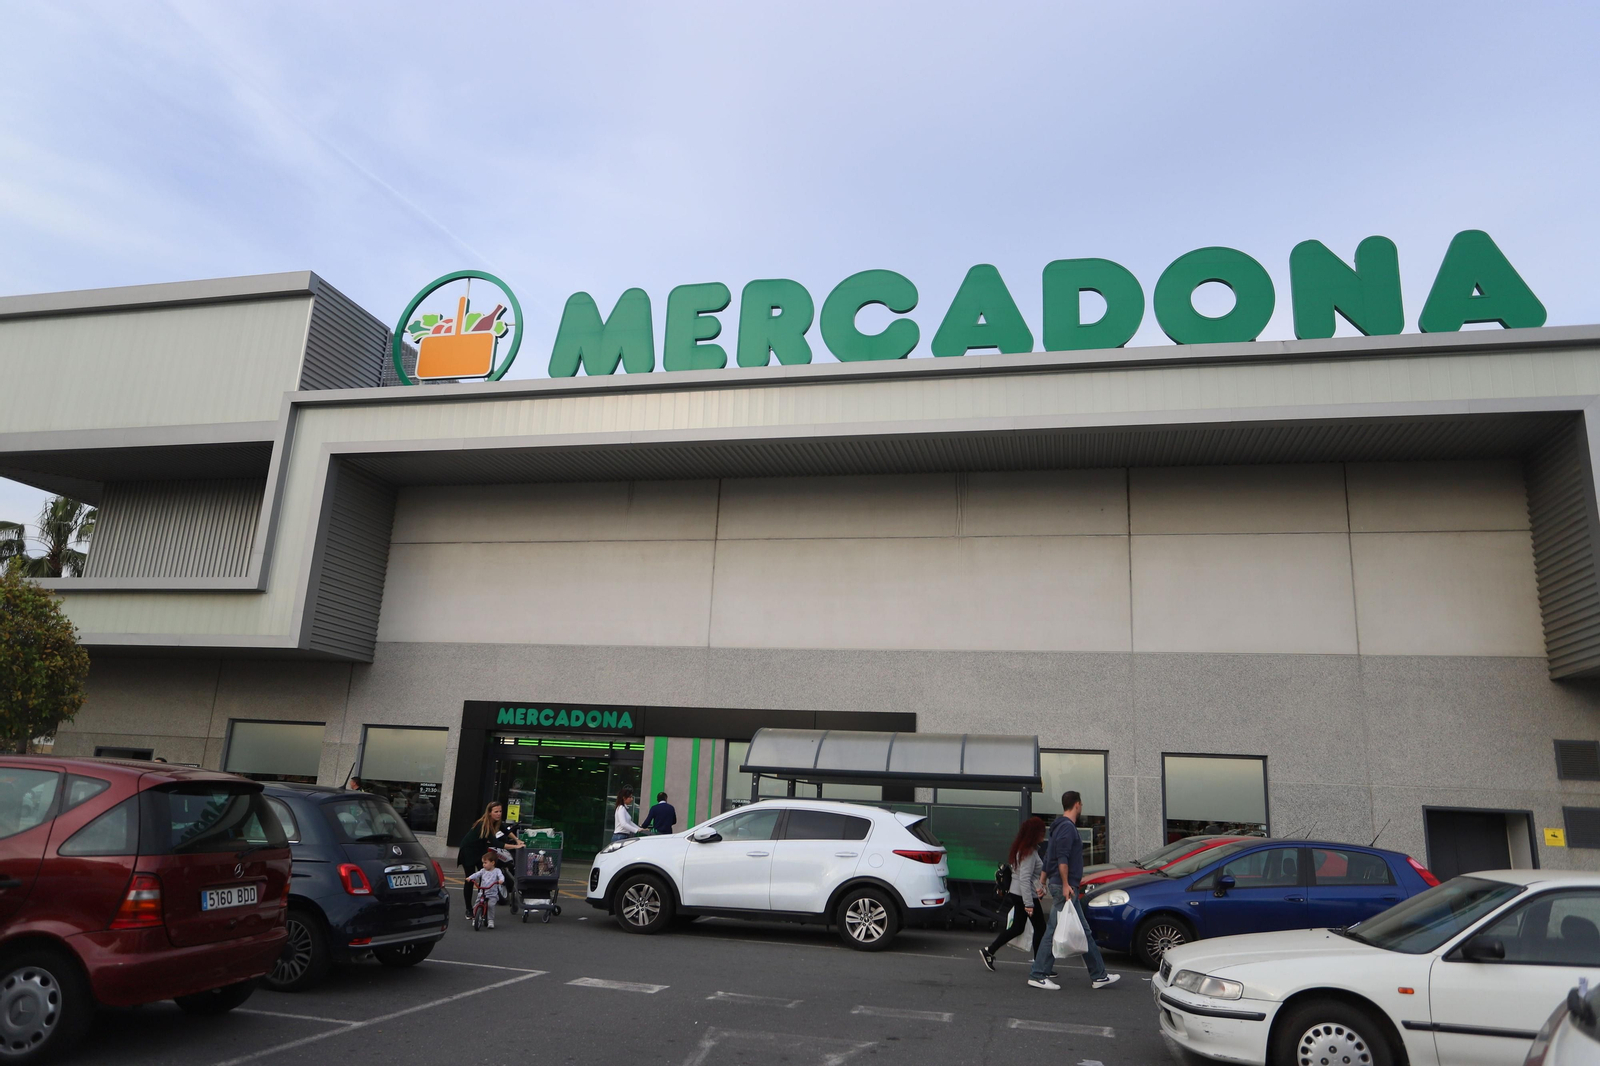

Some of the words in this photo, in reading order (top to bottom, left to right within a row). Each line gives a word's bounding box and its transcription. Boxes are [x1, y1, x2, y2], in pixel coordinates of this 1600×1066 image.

[549, 229, 1547, 378] MERCADONA
[496, 707, 633, 729] MERCADONA
[393, 875, 412, 887] 2232
[208, 890, 233, 907] 5160
[237, 887, 256, 903] BDD
